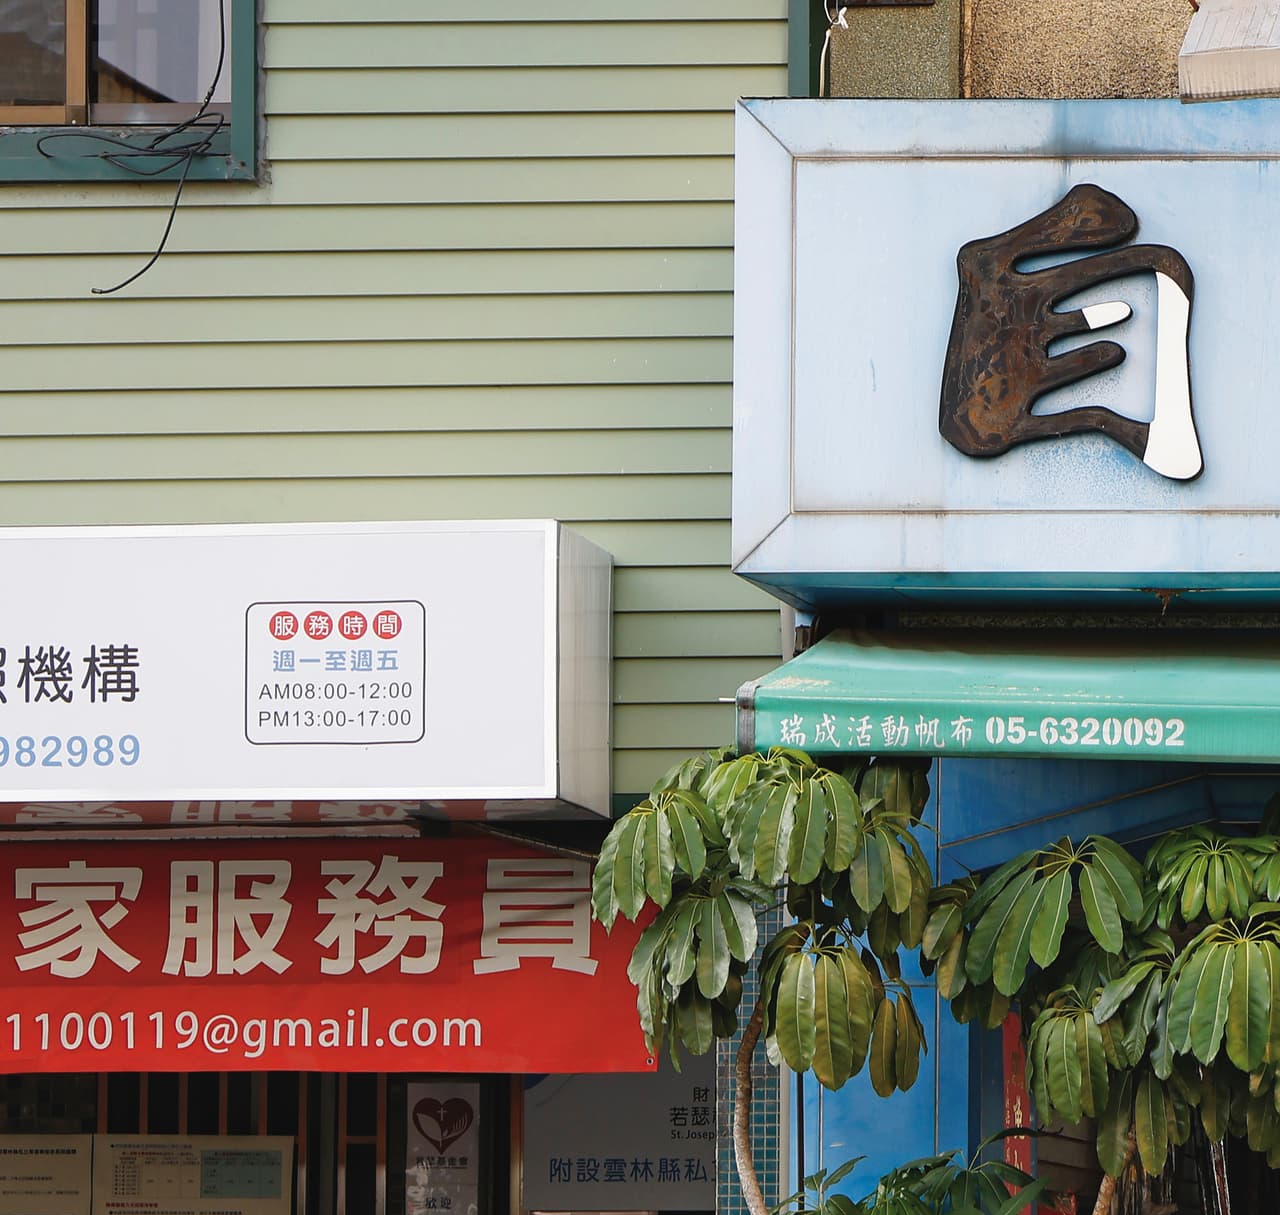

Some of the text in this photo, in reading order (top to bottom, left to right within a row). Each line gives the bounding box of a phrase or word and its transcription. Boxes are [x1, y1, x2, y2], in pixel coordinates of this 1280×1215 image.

[272, 613, 399, 637] 服務時間
[273, 650, 398, 672] 週一至週五
[0, 644, 140, 704] 機構
[259, 682, 412, 700] AM08:00-12:00
[259, 709, 411, 728] PM13:00-17:00
[780, 714, 1185, 748] 瑞成活動帆布 05-6320092
[15, 854, 598, 978] 家服務員
[5, 1008, 482, 1058] 1100119@gmail.com
[670, 1106, 716, 1127] 若瑟
[671, 1129, 717, 1142] St. Josep
[549, 1158, 717, 1183] 附設雲林縣私
